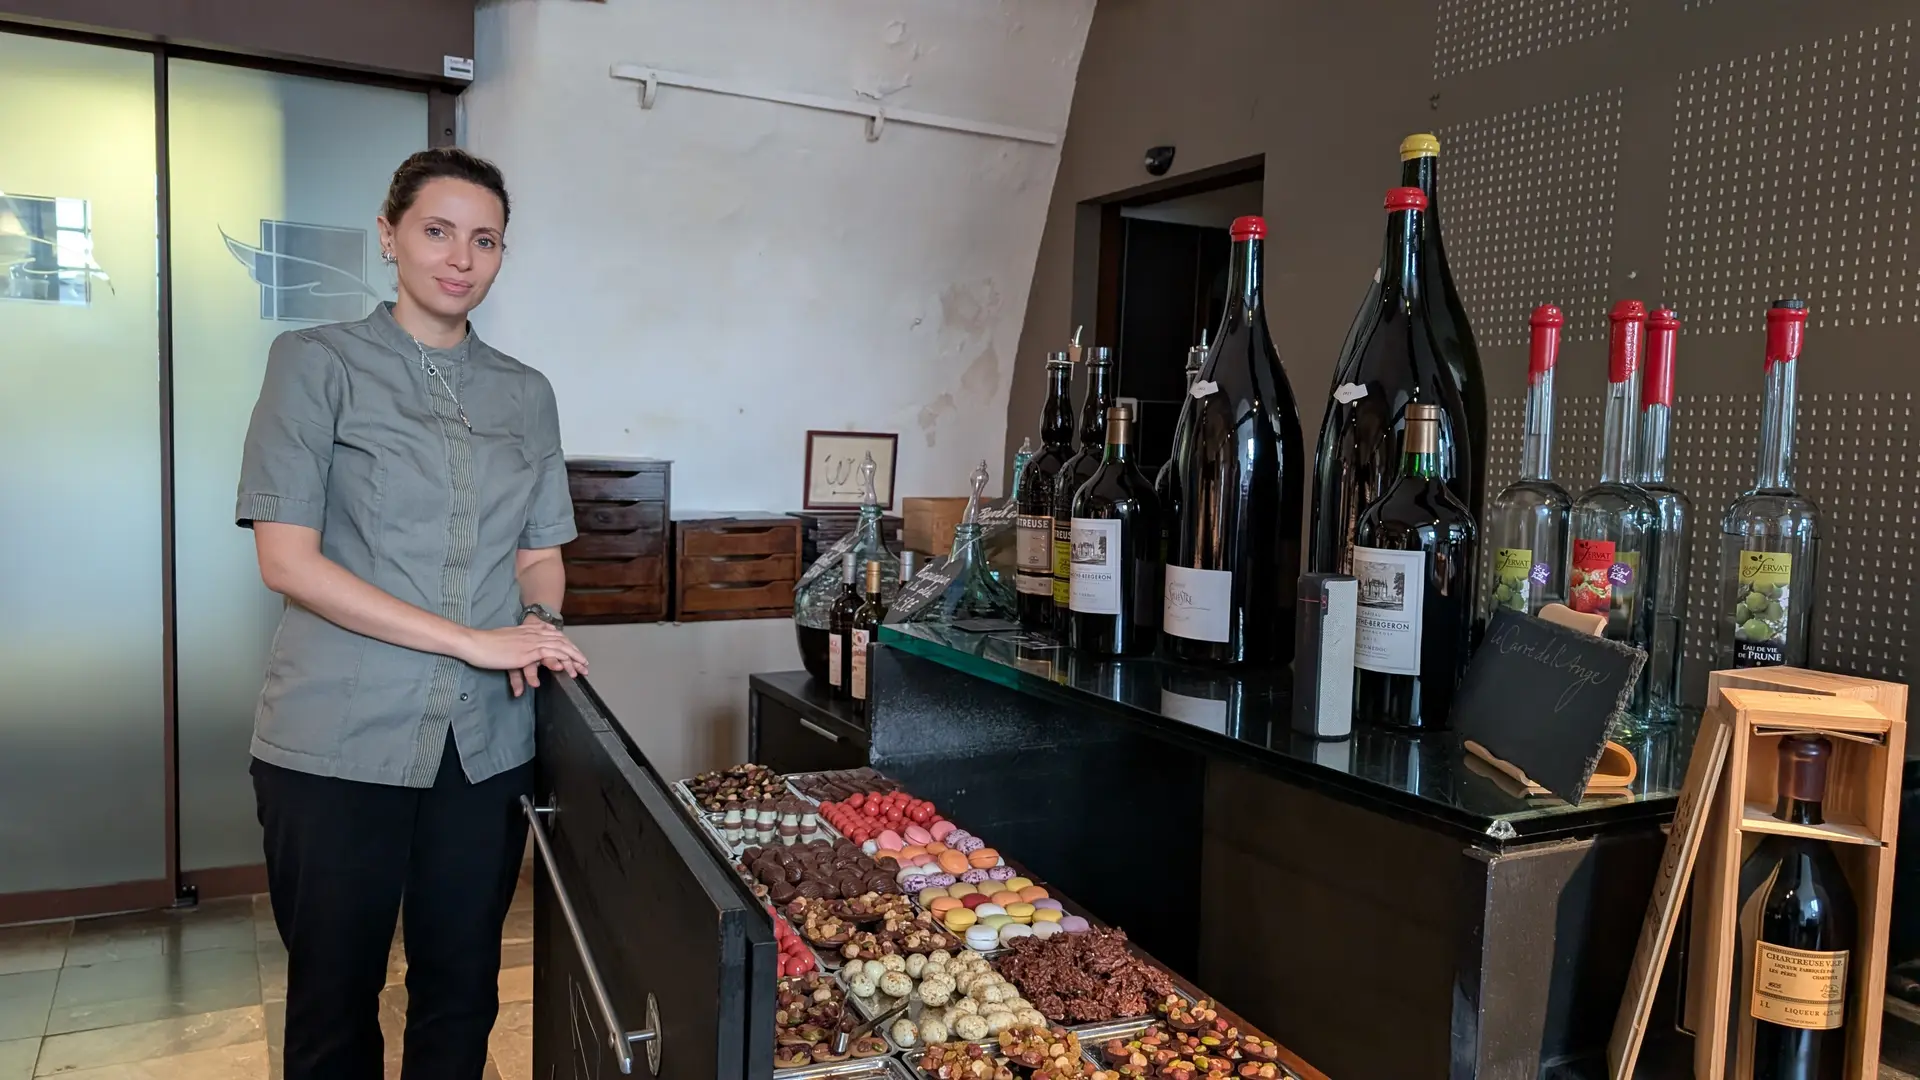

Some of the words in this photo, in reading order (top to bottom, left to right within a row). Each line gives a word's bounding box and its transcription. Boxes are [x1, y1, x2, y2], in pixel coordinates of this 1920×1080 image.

[1748, 650, 1782, 662] PRUNE
[1766, 952, 1825, 967] CHARTREUSE
[1784, 1007, 1820, 1017] LIQUEUR
